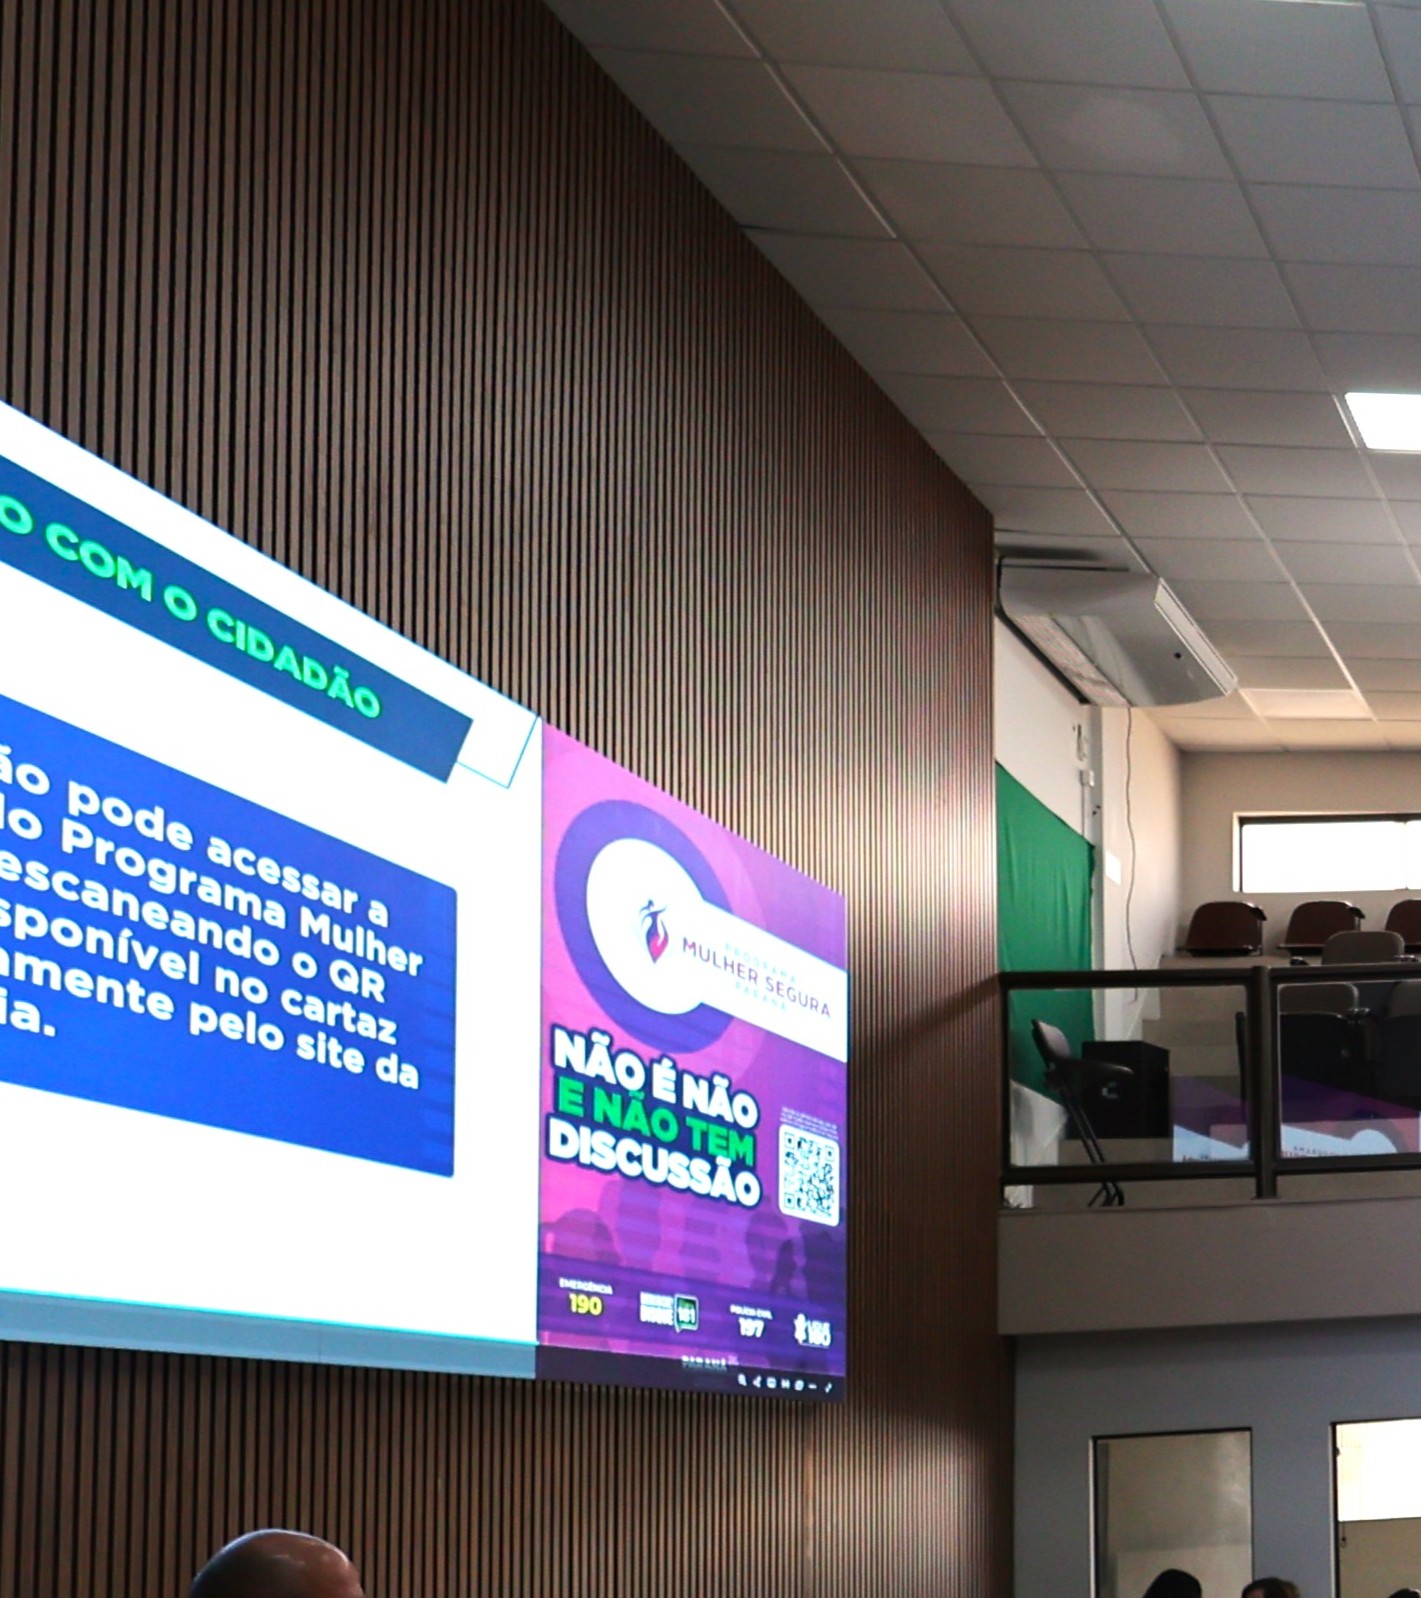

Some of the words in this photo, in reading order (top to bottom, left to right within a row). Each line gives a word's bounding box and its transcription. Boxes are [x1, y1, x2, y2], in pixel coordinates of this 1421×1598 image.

[45, 523, 154, 602] COM
[163, 586, 198, 622] O
[207, 608, 382, 719] CIDADÃO
[62, 816, 287, 929] Programa
[300, 906, 424, 977] Mulher
[68, 779, 194, 851] pode
[207, 835, 358, 914] acessar
[368, 899, 389, 928] a
[0, 849, 280, 967] escaneando
[292, 952, 318, 979] o
[329, 959, 386, 1004] QR
[215, 966, 269, 1004] no
[281, 987, 398, 1045] cartaz
[682, 936, 759, 986] MULHER
[765, 975, 832, 1020] SEGURA
[190, 1001, 285, 1051] pelo
[297, 1031, 365, 1075] site
[375, 1053, 420, 1090] da
[553, 1026, 647, 1093] NÃO
[652, 1056, 677, 1104] É
[683, 1073, 759, 1129] NÃO
[549, 1117, 761, 1208] DISCUSSÃO
[558, 1075, 585, 1118] E
[594, 1086, 679, 1143] NÃO
[686, 1116, 755, 1167] TEM
[569, 1293, 602, 1316] 190
